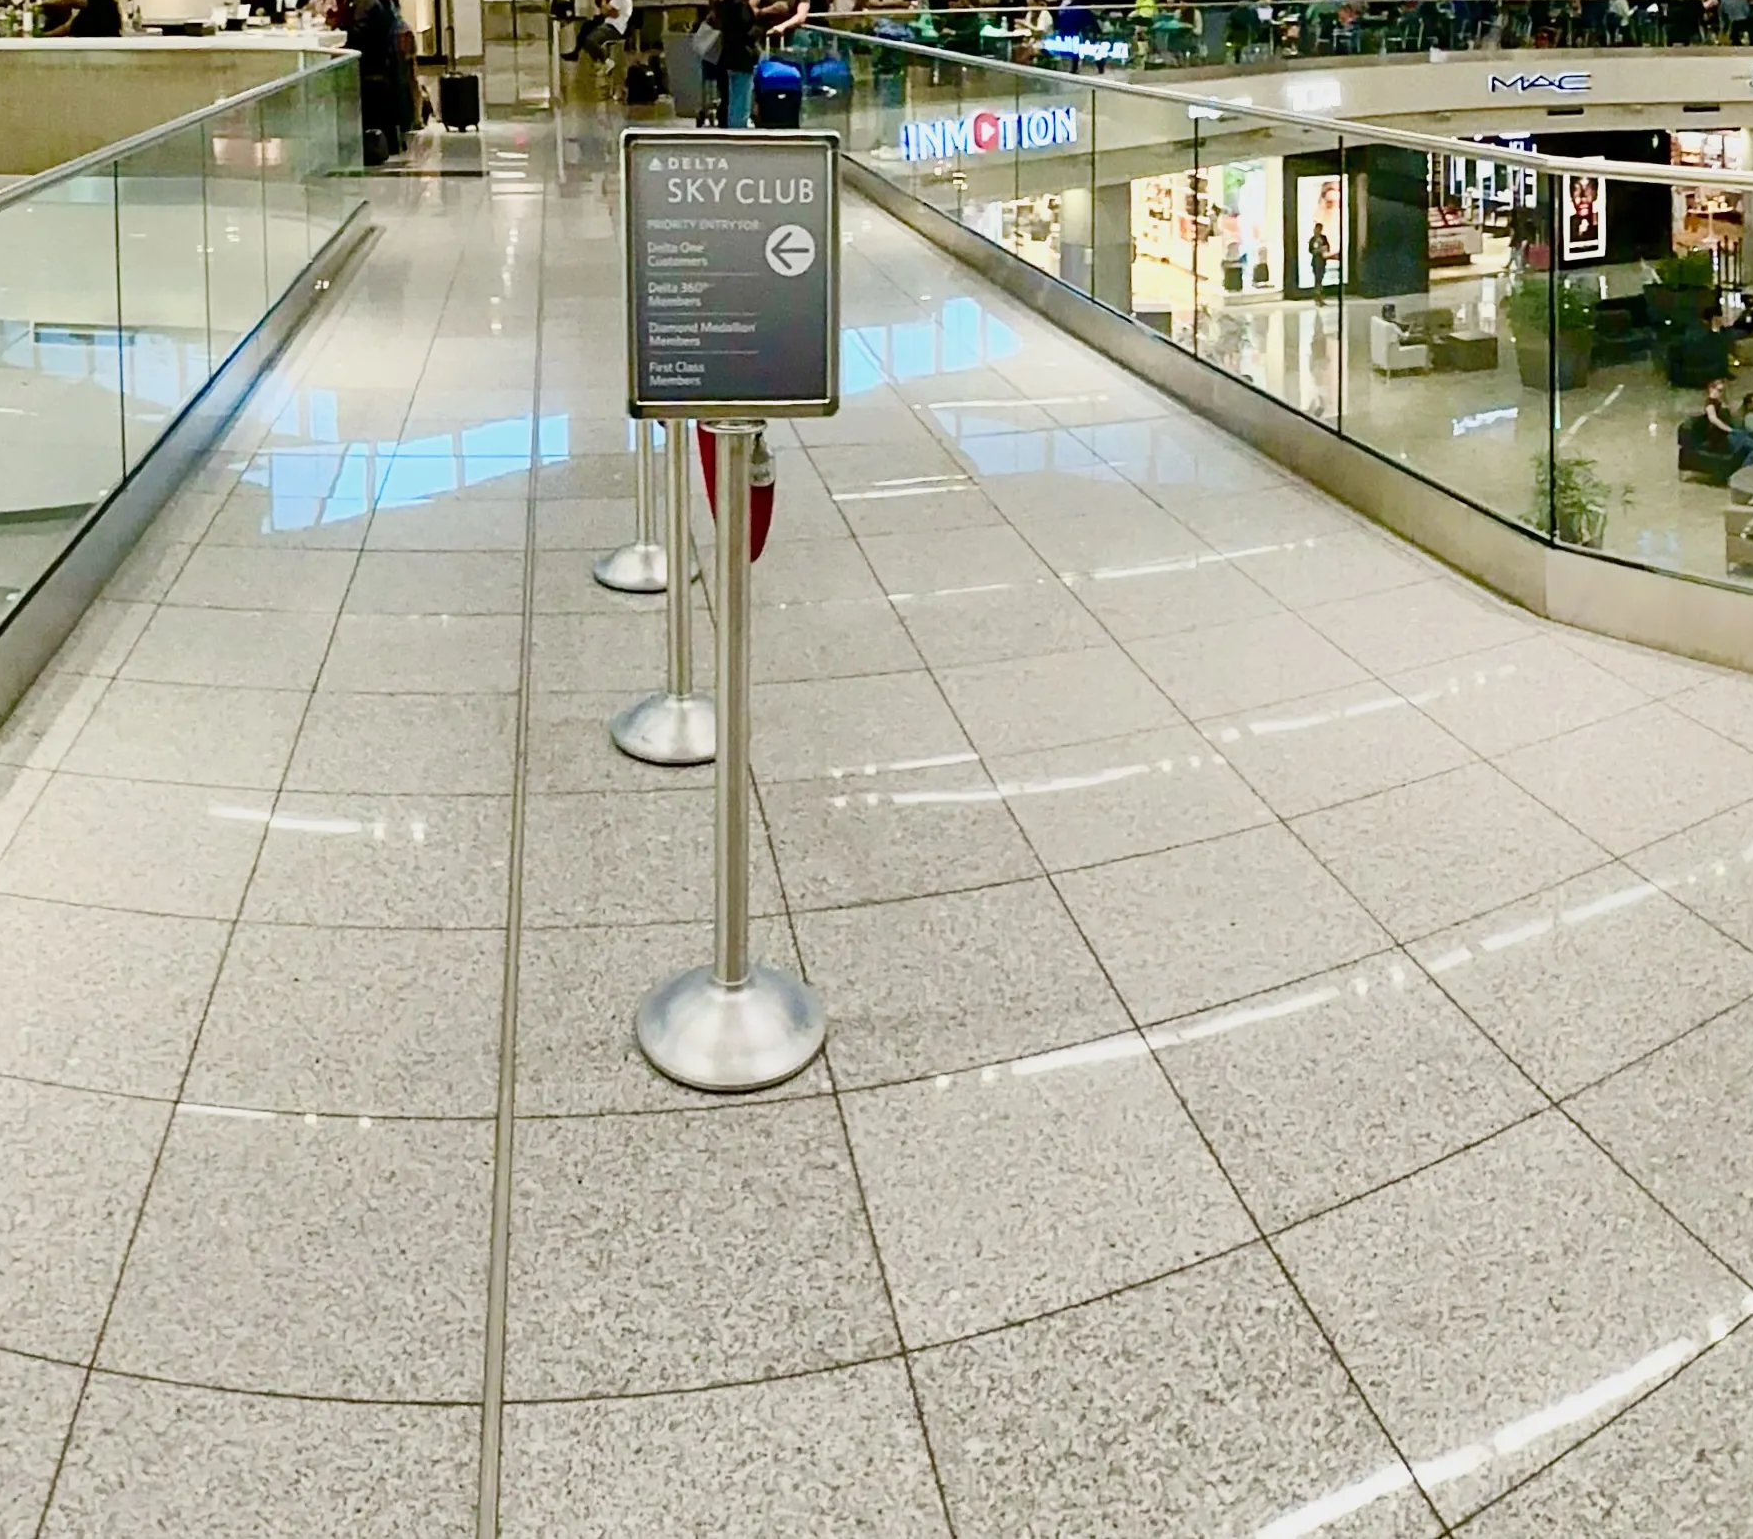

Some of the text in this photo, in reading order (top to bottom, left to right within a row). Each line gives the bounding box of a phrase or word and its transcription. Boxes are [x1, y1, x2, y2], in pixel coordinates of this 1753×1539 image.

[668, 157, 729, 170] DELTA
[667, 177, 814, 204] SKY CLUB
[646, 219, 697, 230] PRIORITY
[699, 219, 736, 230] ENTRY
[647, 241, 678, 253] Delta
[647, 255, 709, 267] Customers
[647, 281, 678, 294] Delta
[648, 296, 702, 307] Members
[648, 322, 699, 334] Diamond
[648, 335, 701, 347] Members
[648, 362, 706, 373] First Class
[649, 375, 702, 387] Members
